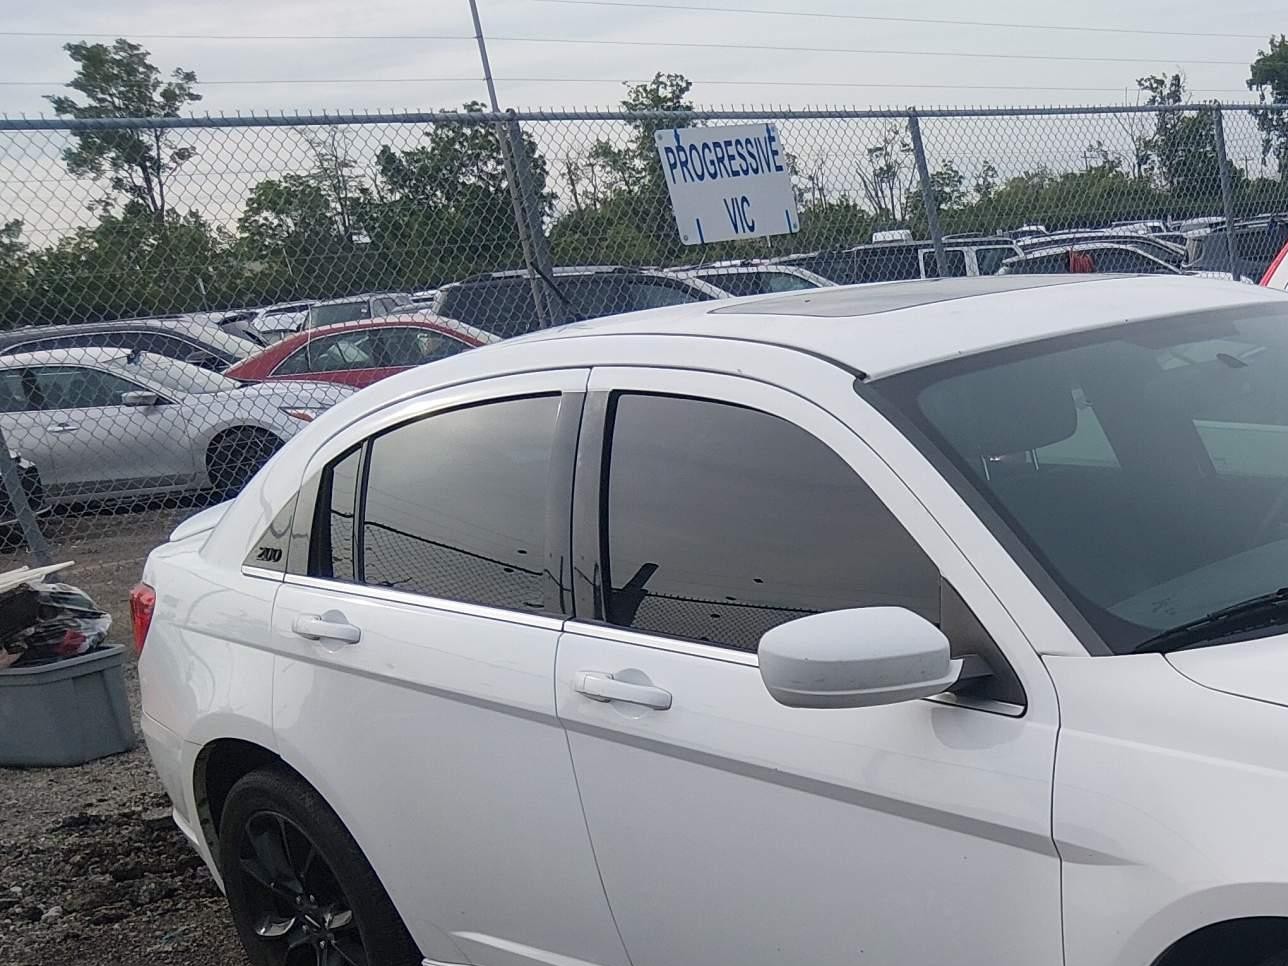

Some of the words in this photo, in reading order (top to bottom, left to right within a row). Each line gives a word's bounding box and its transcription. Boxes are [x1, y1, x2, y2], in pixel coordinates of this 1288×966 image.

[664, 135, 783, 184] PROGRESSIVE
[723, 195, 756, 234] VIC
[256, 547, 283, 563] 200
